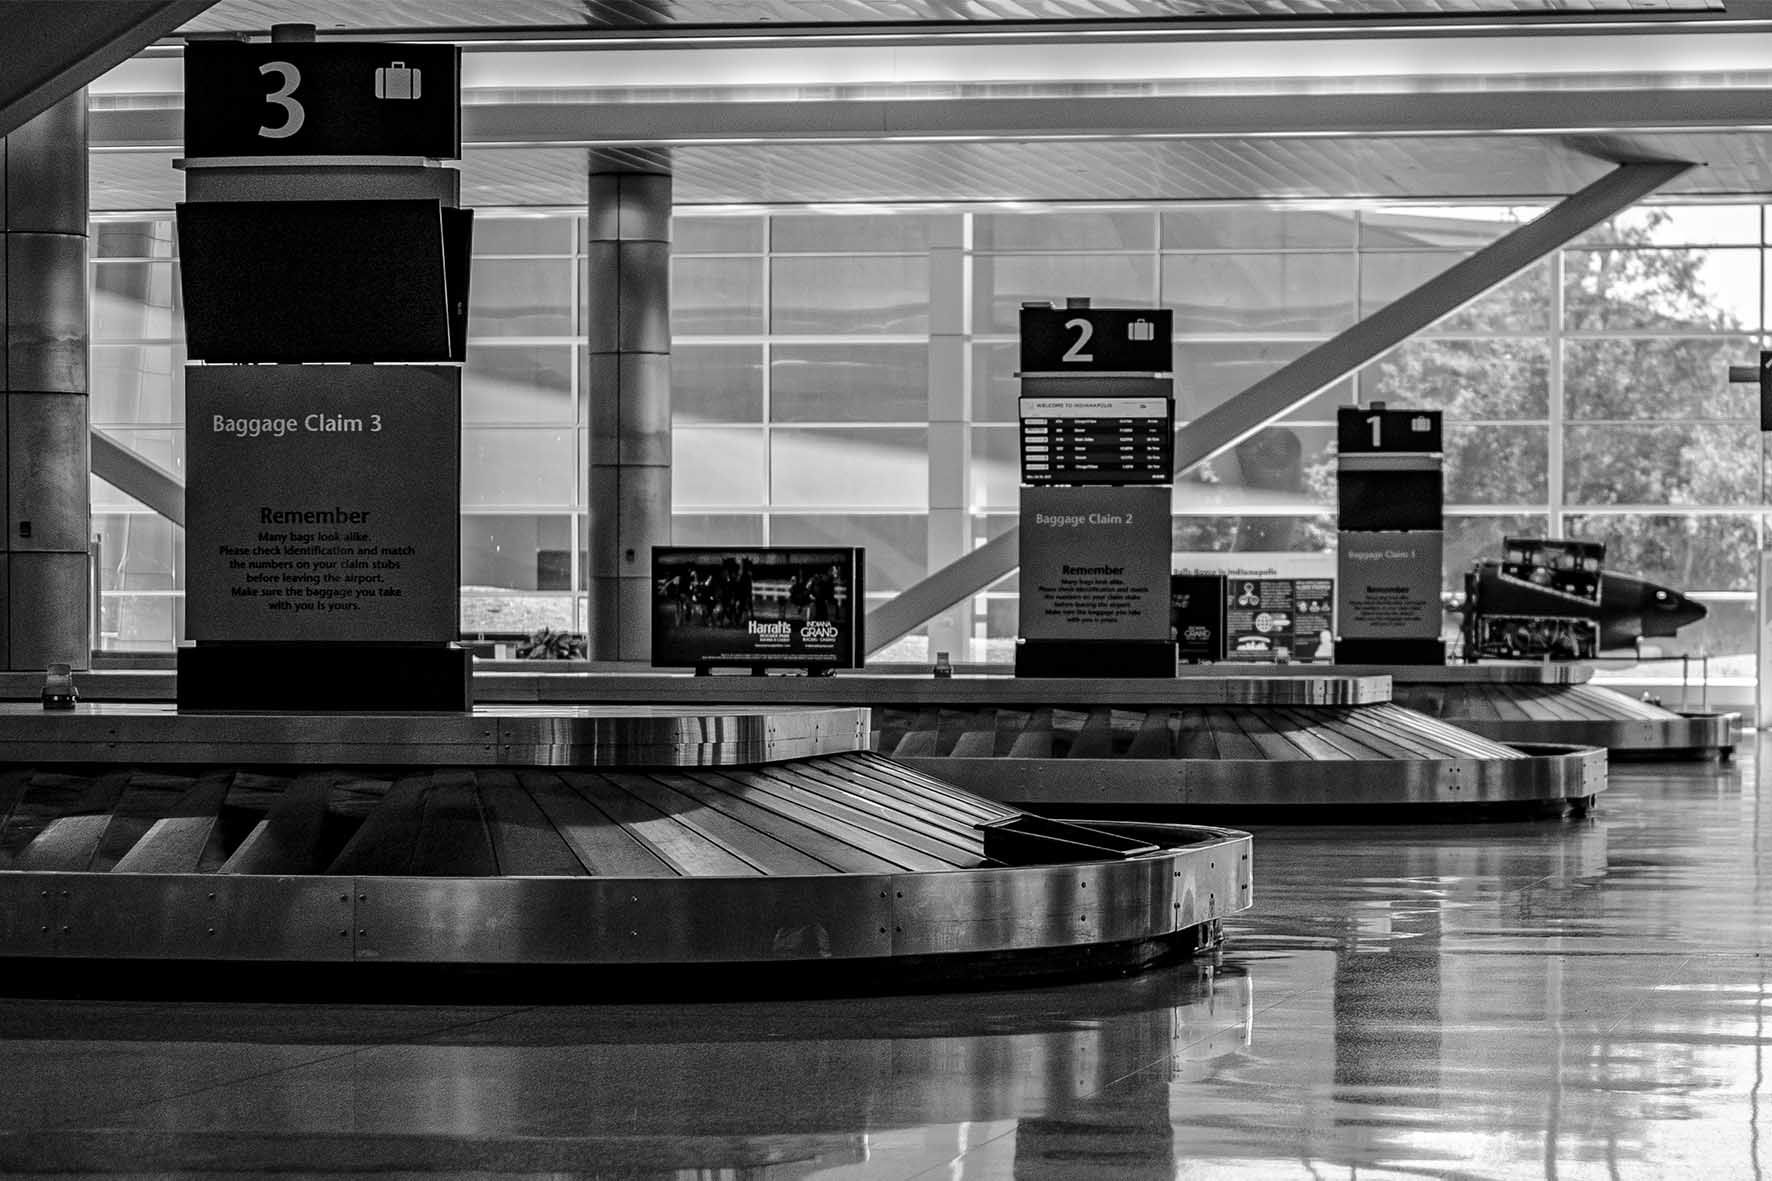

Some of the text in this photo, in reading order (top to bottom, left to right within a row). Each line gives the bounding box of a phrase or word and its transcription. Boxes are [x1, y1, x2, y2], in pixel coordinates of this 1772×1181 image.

[259, 62, 304, 138] 3
[1063, 319, 1093, 361] 2
[213, 413, 382, 437] Baggage Claim 3
[1366, 416, 1380, 446] 1
[260, 506, 370, 524] Remember
[1036, 513, 1133, 527] Baggage Claim 2
[258, 532, 371, 544] Many bags look alike.
[219, 545, 415, 555] Please check identification and match
[229, 559, 246, 569] the
[248, 559, 293, 569] numbers
[312, 562, 337, 571] your
[340, 559, 369, 569] claim
[372, 559, 401, 569] stubs
[1062, 564, 1124, 575] Remember
[246, 573, 385, 585] before leaving the airport.
[231, 587, 402, 599] Make sure the baggage you take
[268, 601, 361, 612] with you is yours.
[800, 627, 838, 638] GRAND
